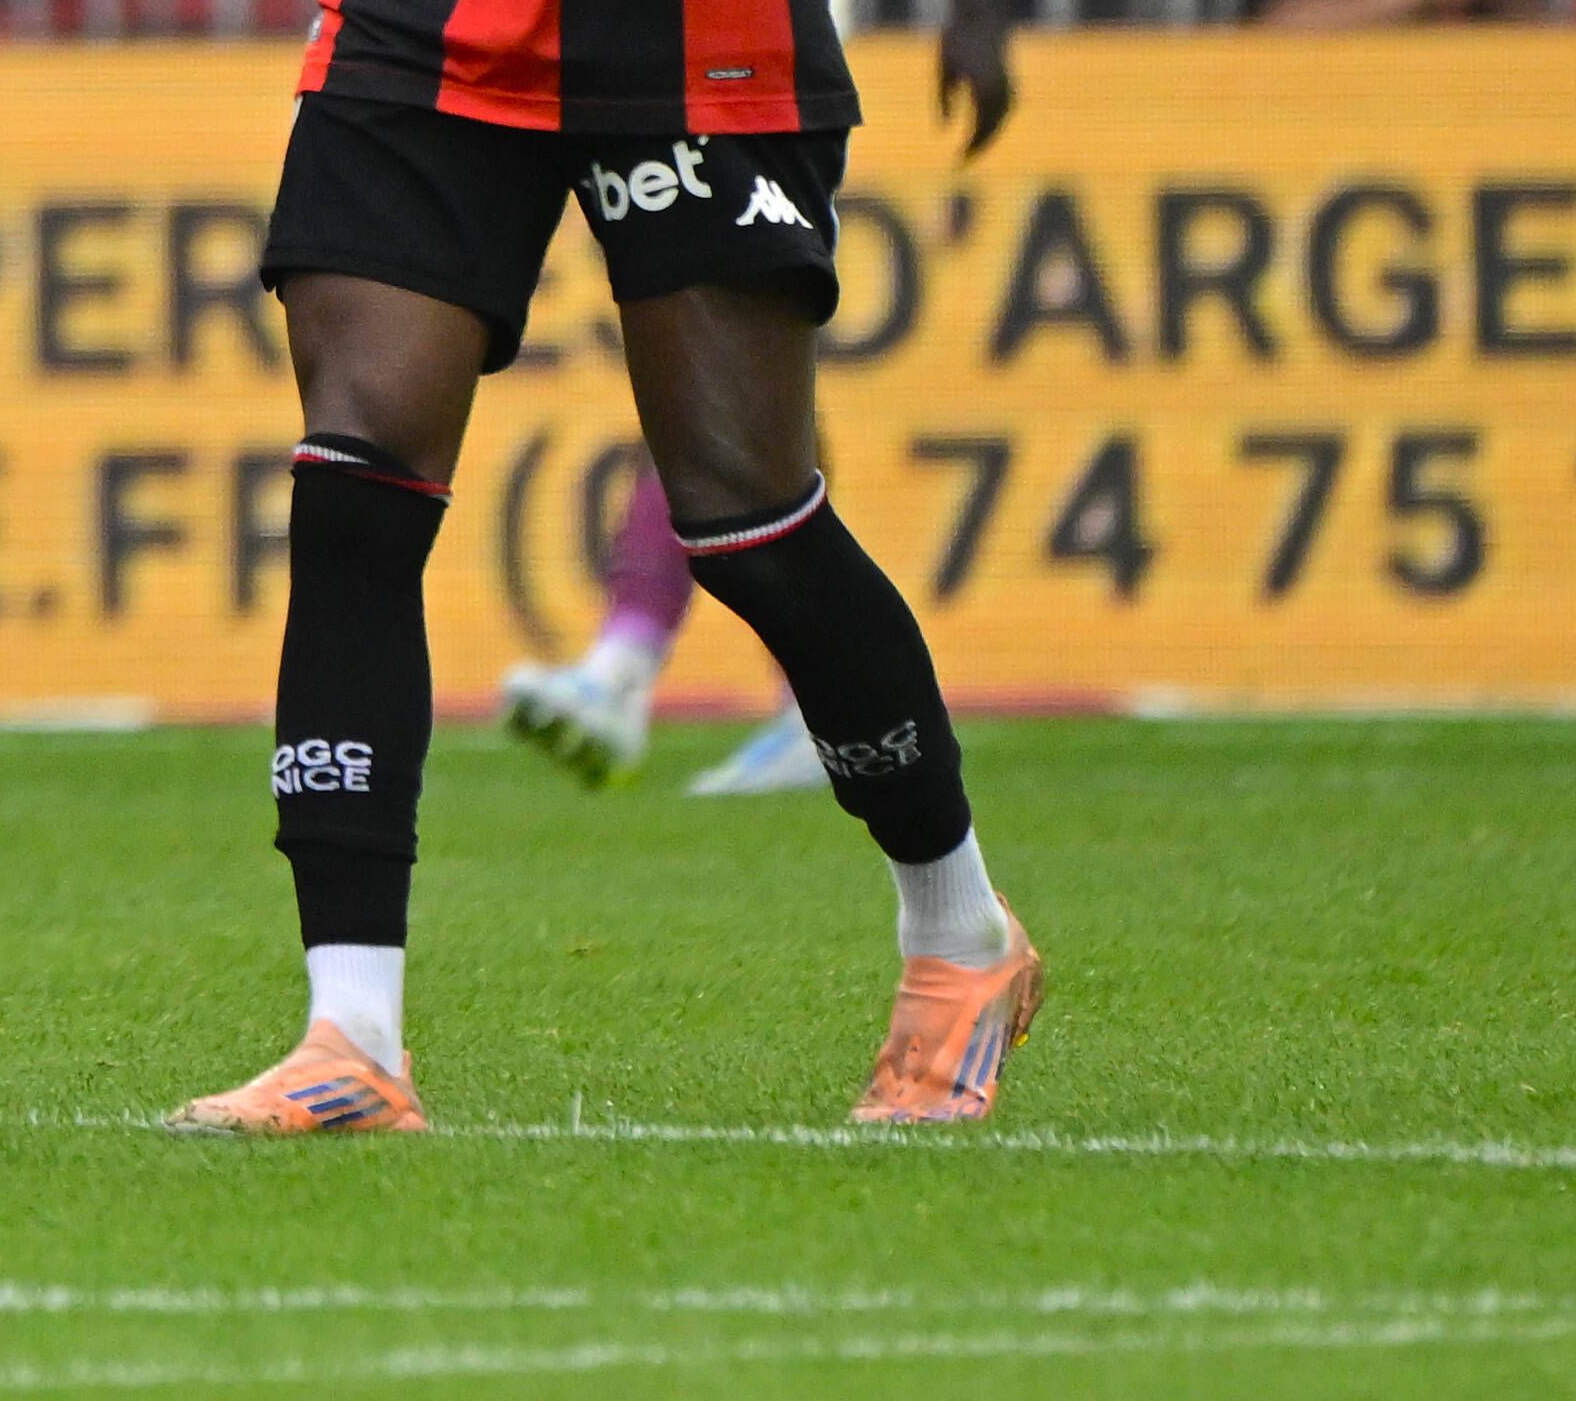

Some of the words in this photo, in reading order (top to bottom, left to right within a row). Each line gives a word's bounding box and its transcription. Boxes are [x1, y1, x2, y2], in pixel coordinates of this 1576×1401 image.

[910, 430, 1154, 600] 74
[1238, 426, 1488, 600] 75
[272, 738, 373, 773] OGC
[272, 766, 371, 798] NICE
